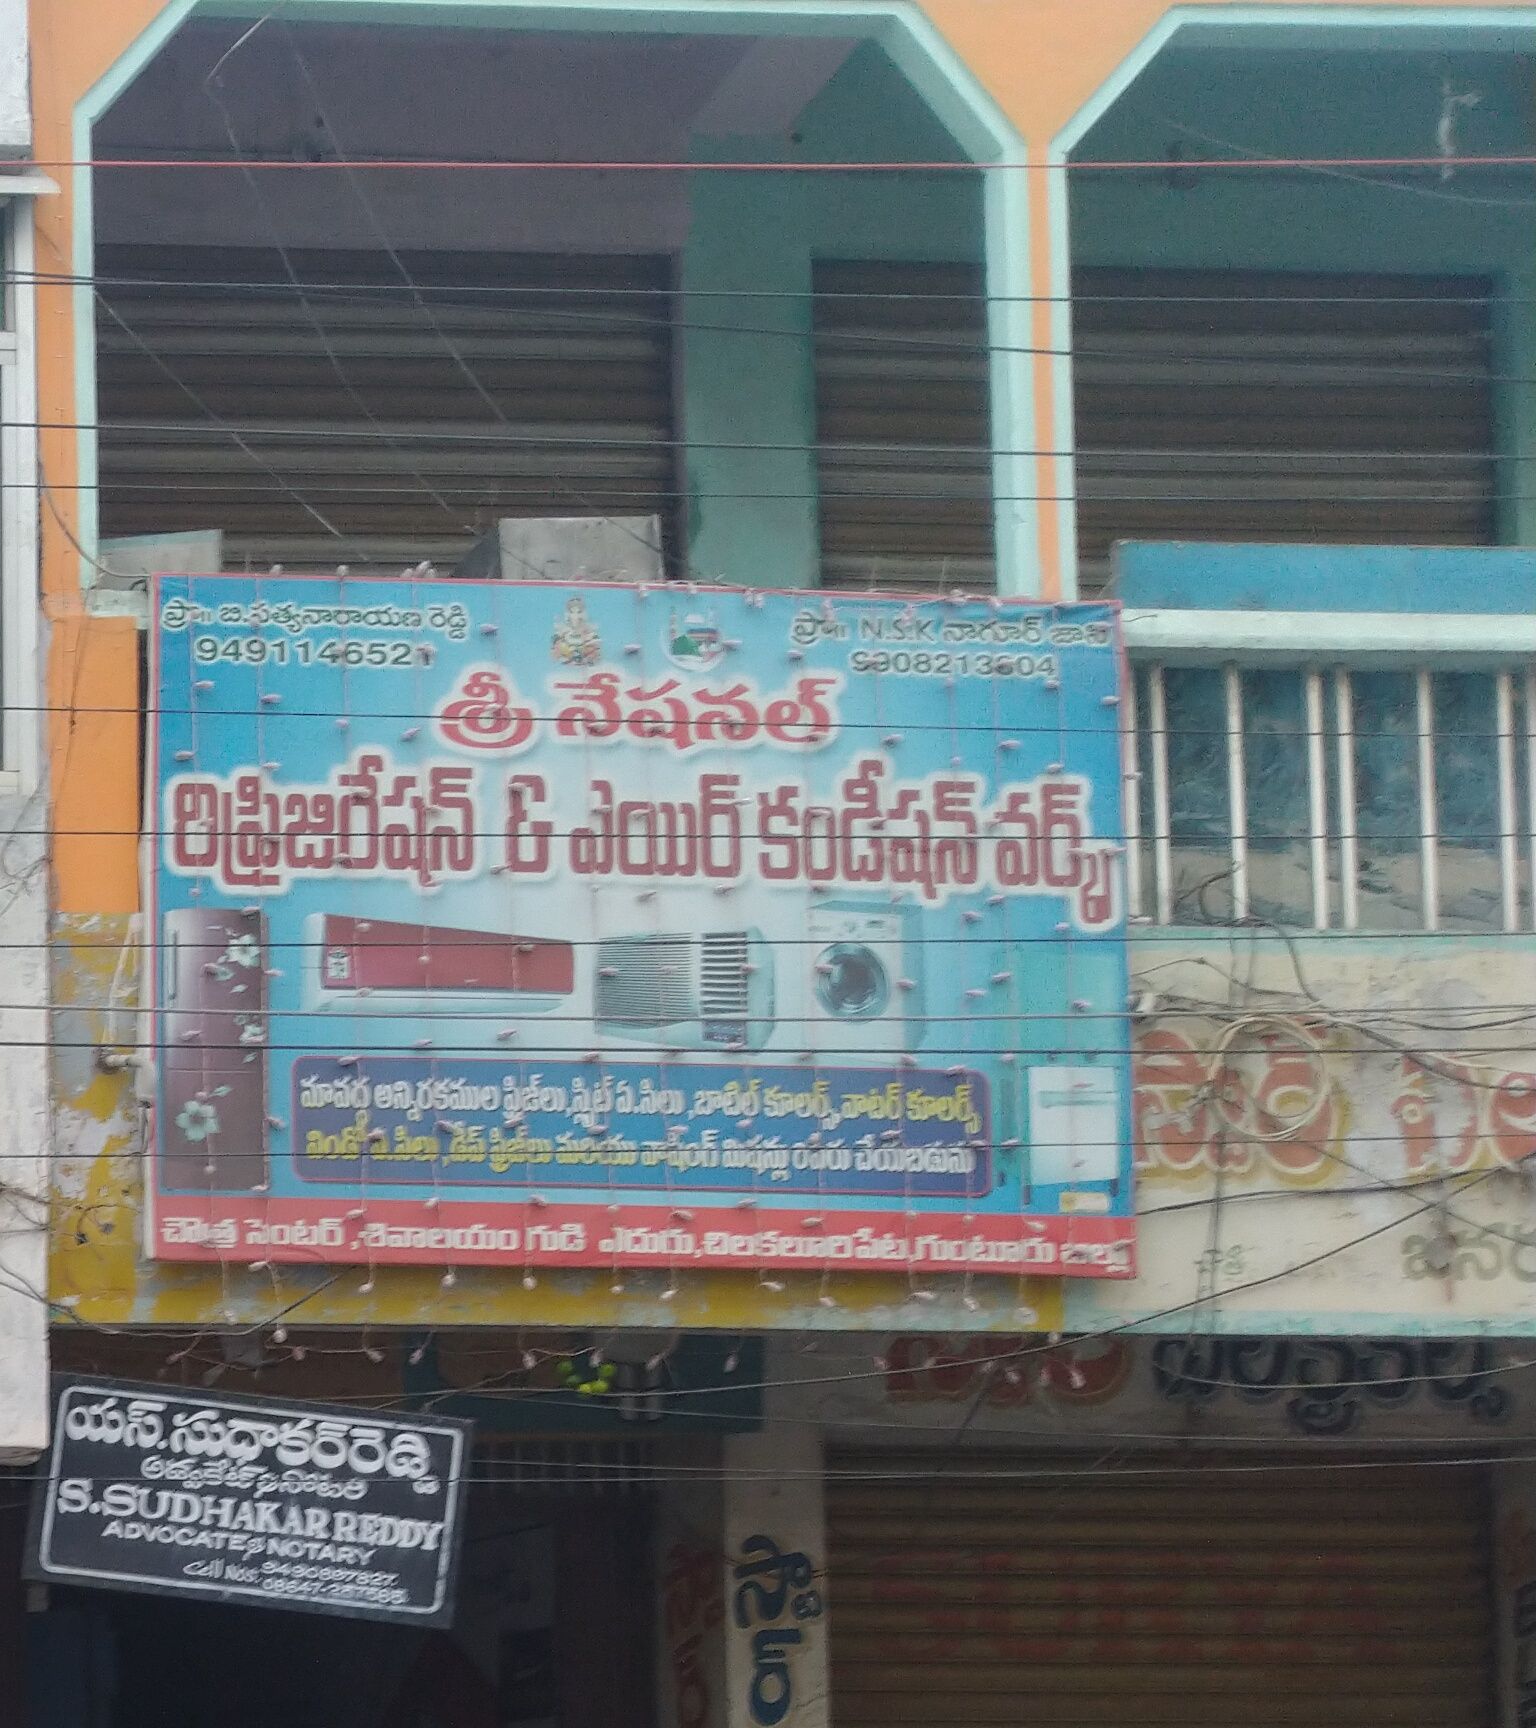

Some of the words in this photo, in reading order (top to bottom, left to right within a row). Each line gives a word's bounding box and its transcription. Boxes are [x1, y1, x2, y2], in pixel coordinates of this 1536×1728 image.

[439, 670, 533, 750] శ్రీ
[555, 671, 839, 751] నేషనల్
[57, 1477, 331, 1540] S.SUDHAKAR
[332, 1509, 445, 1551] REDDY
[101, 1519, 251, 1553] ADVOCATE
[266, 1535, 377, 1566] NOTARY
